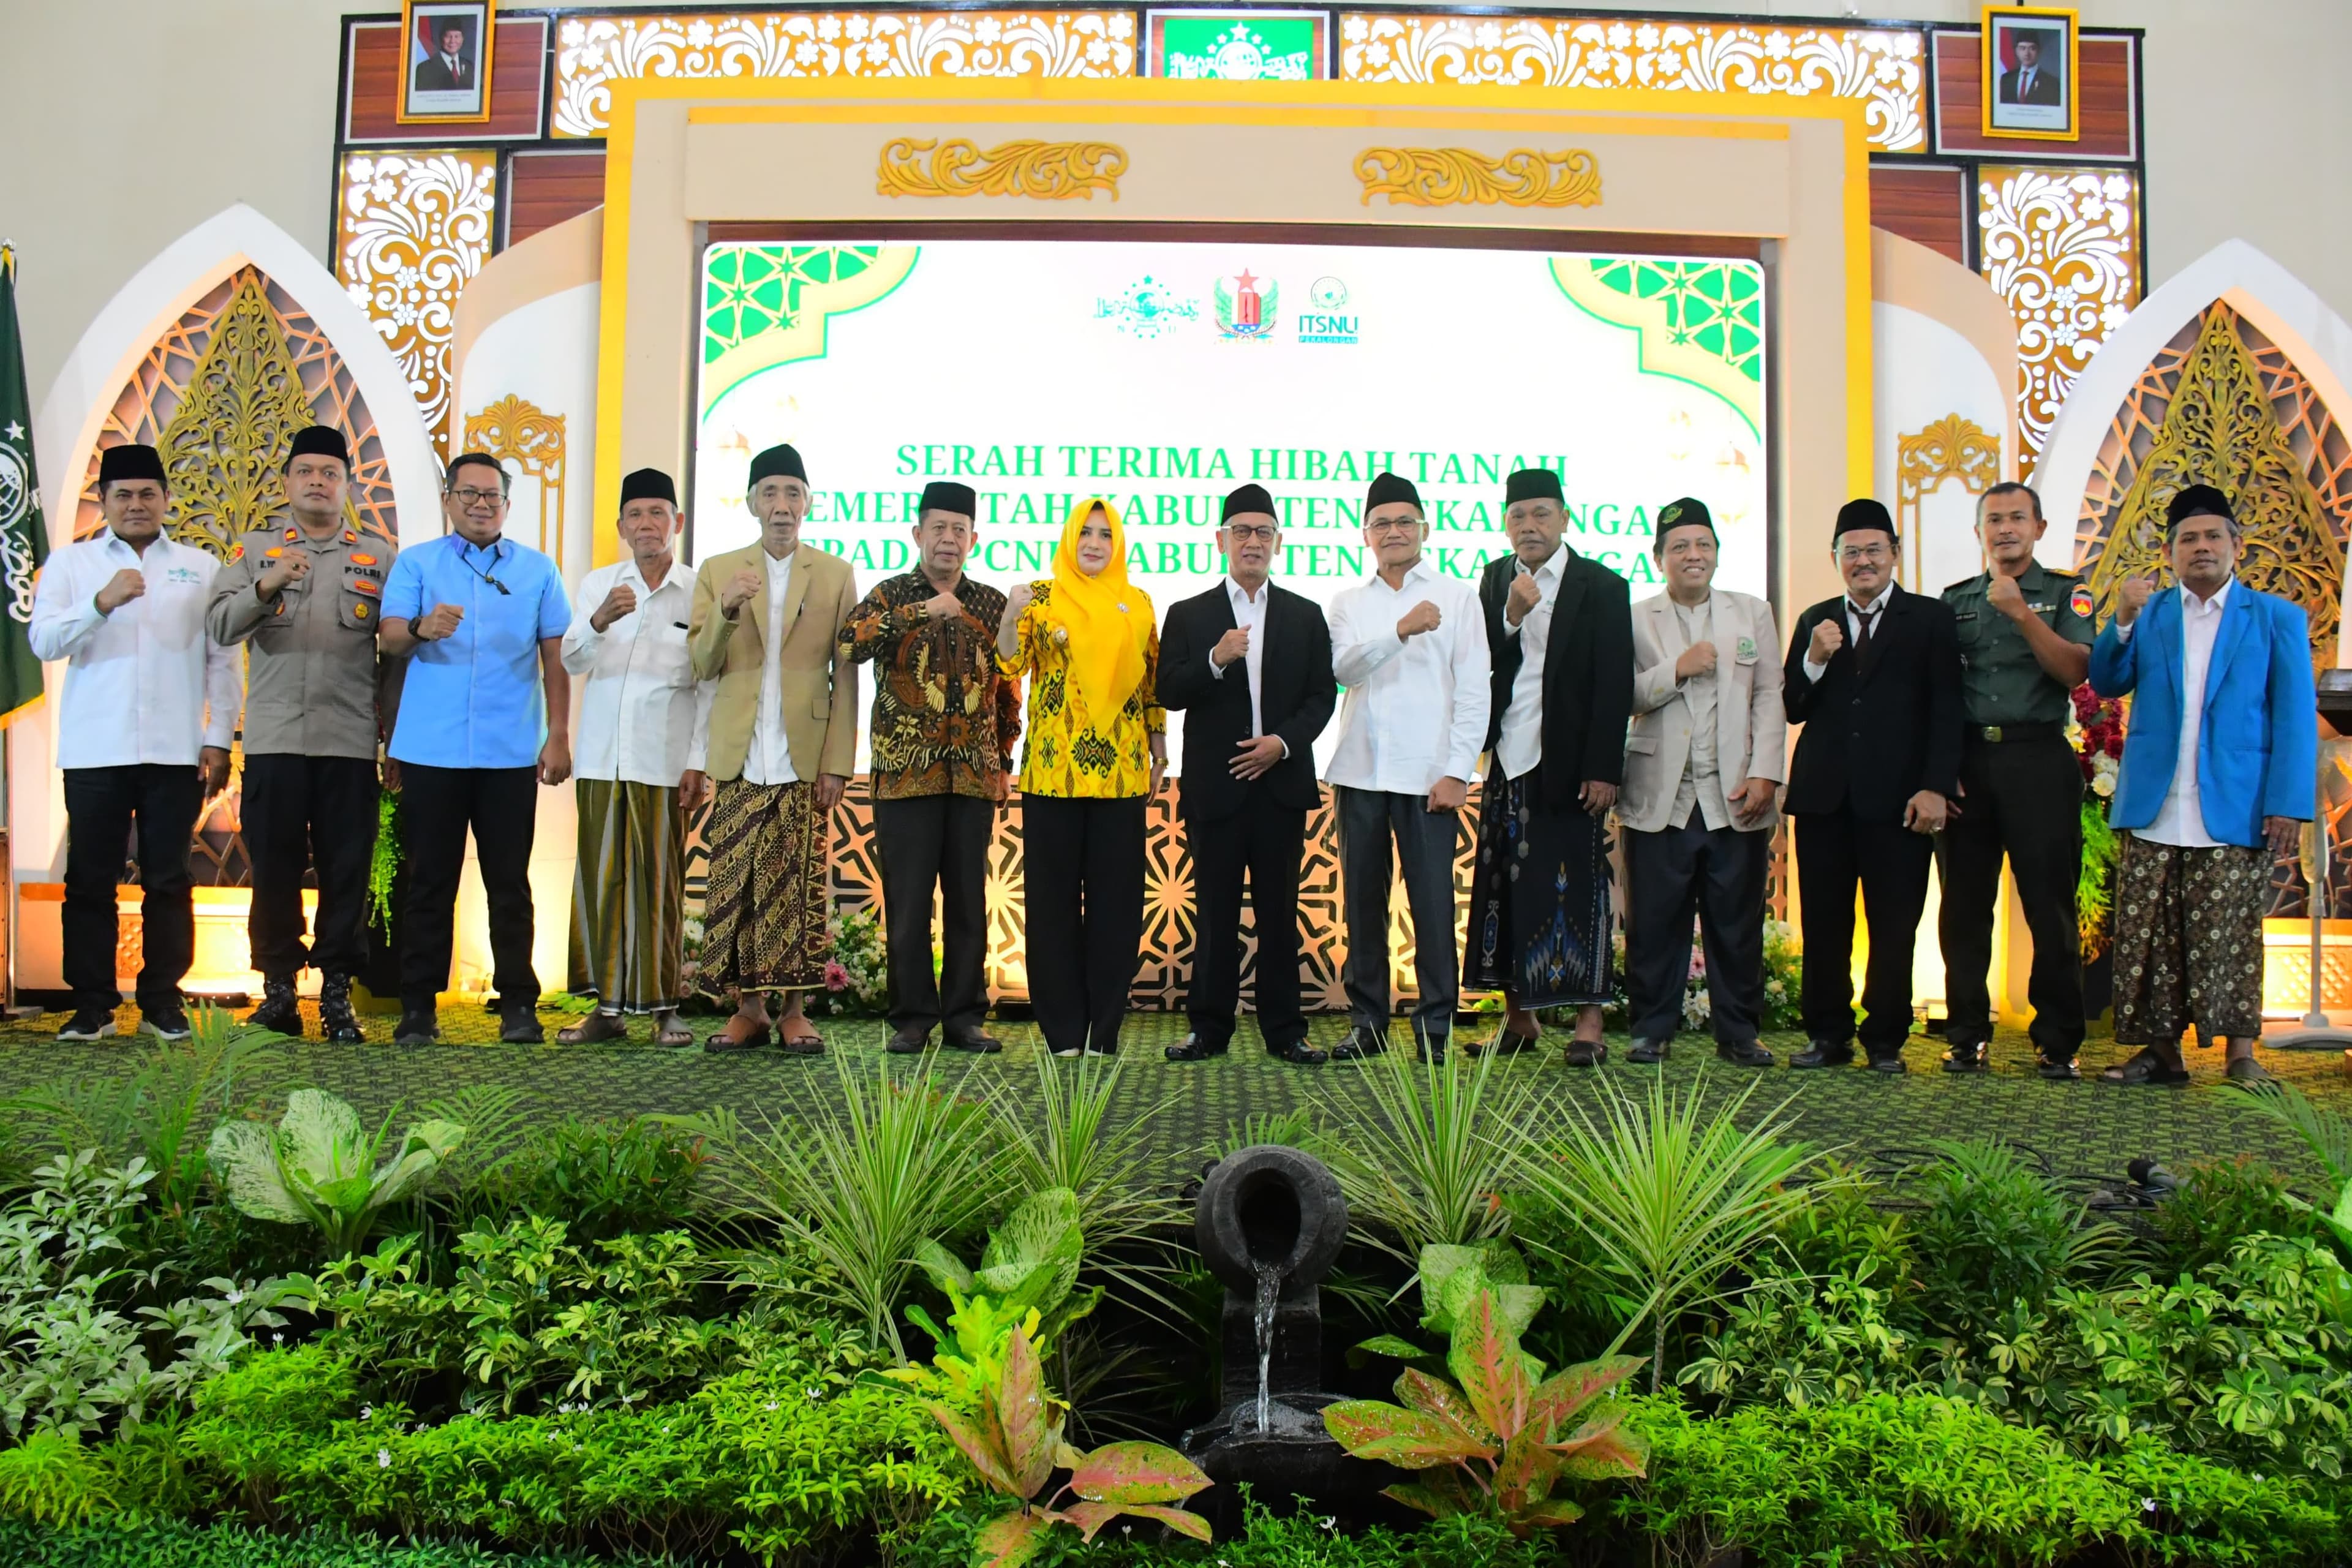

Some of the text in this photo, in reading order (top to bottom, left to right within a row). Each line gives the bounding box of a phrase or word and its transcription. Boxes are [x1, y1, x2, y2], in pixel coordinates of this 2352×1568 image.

[1299, 315, 1358, 333] ITSNU
[896, 445, 1044, 477] SERAH
[1058, 446, 1235, 480] TERIMA
[1251, 448, 1395, 483] HIBAH
[344, 566, 380, 579] POLRI
